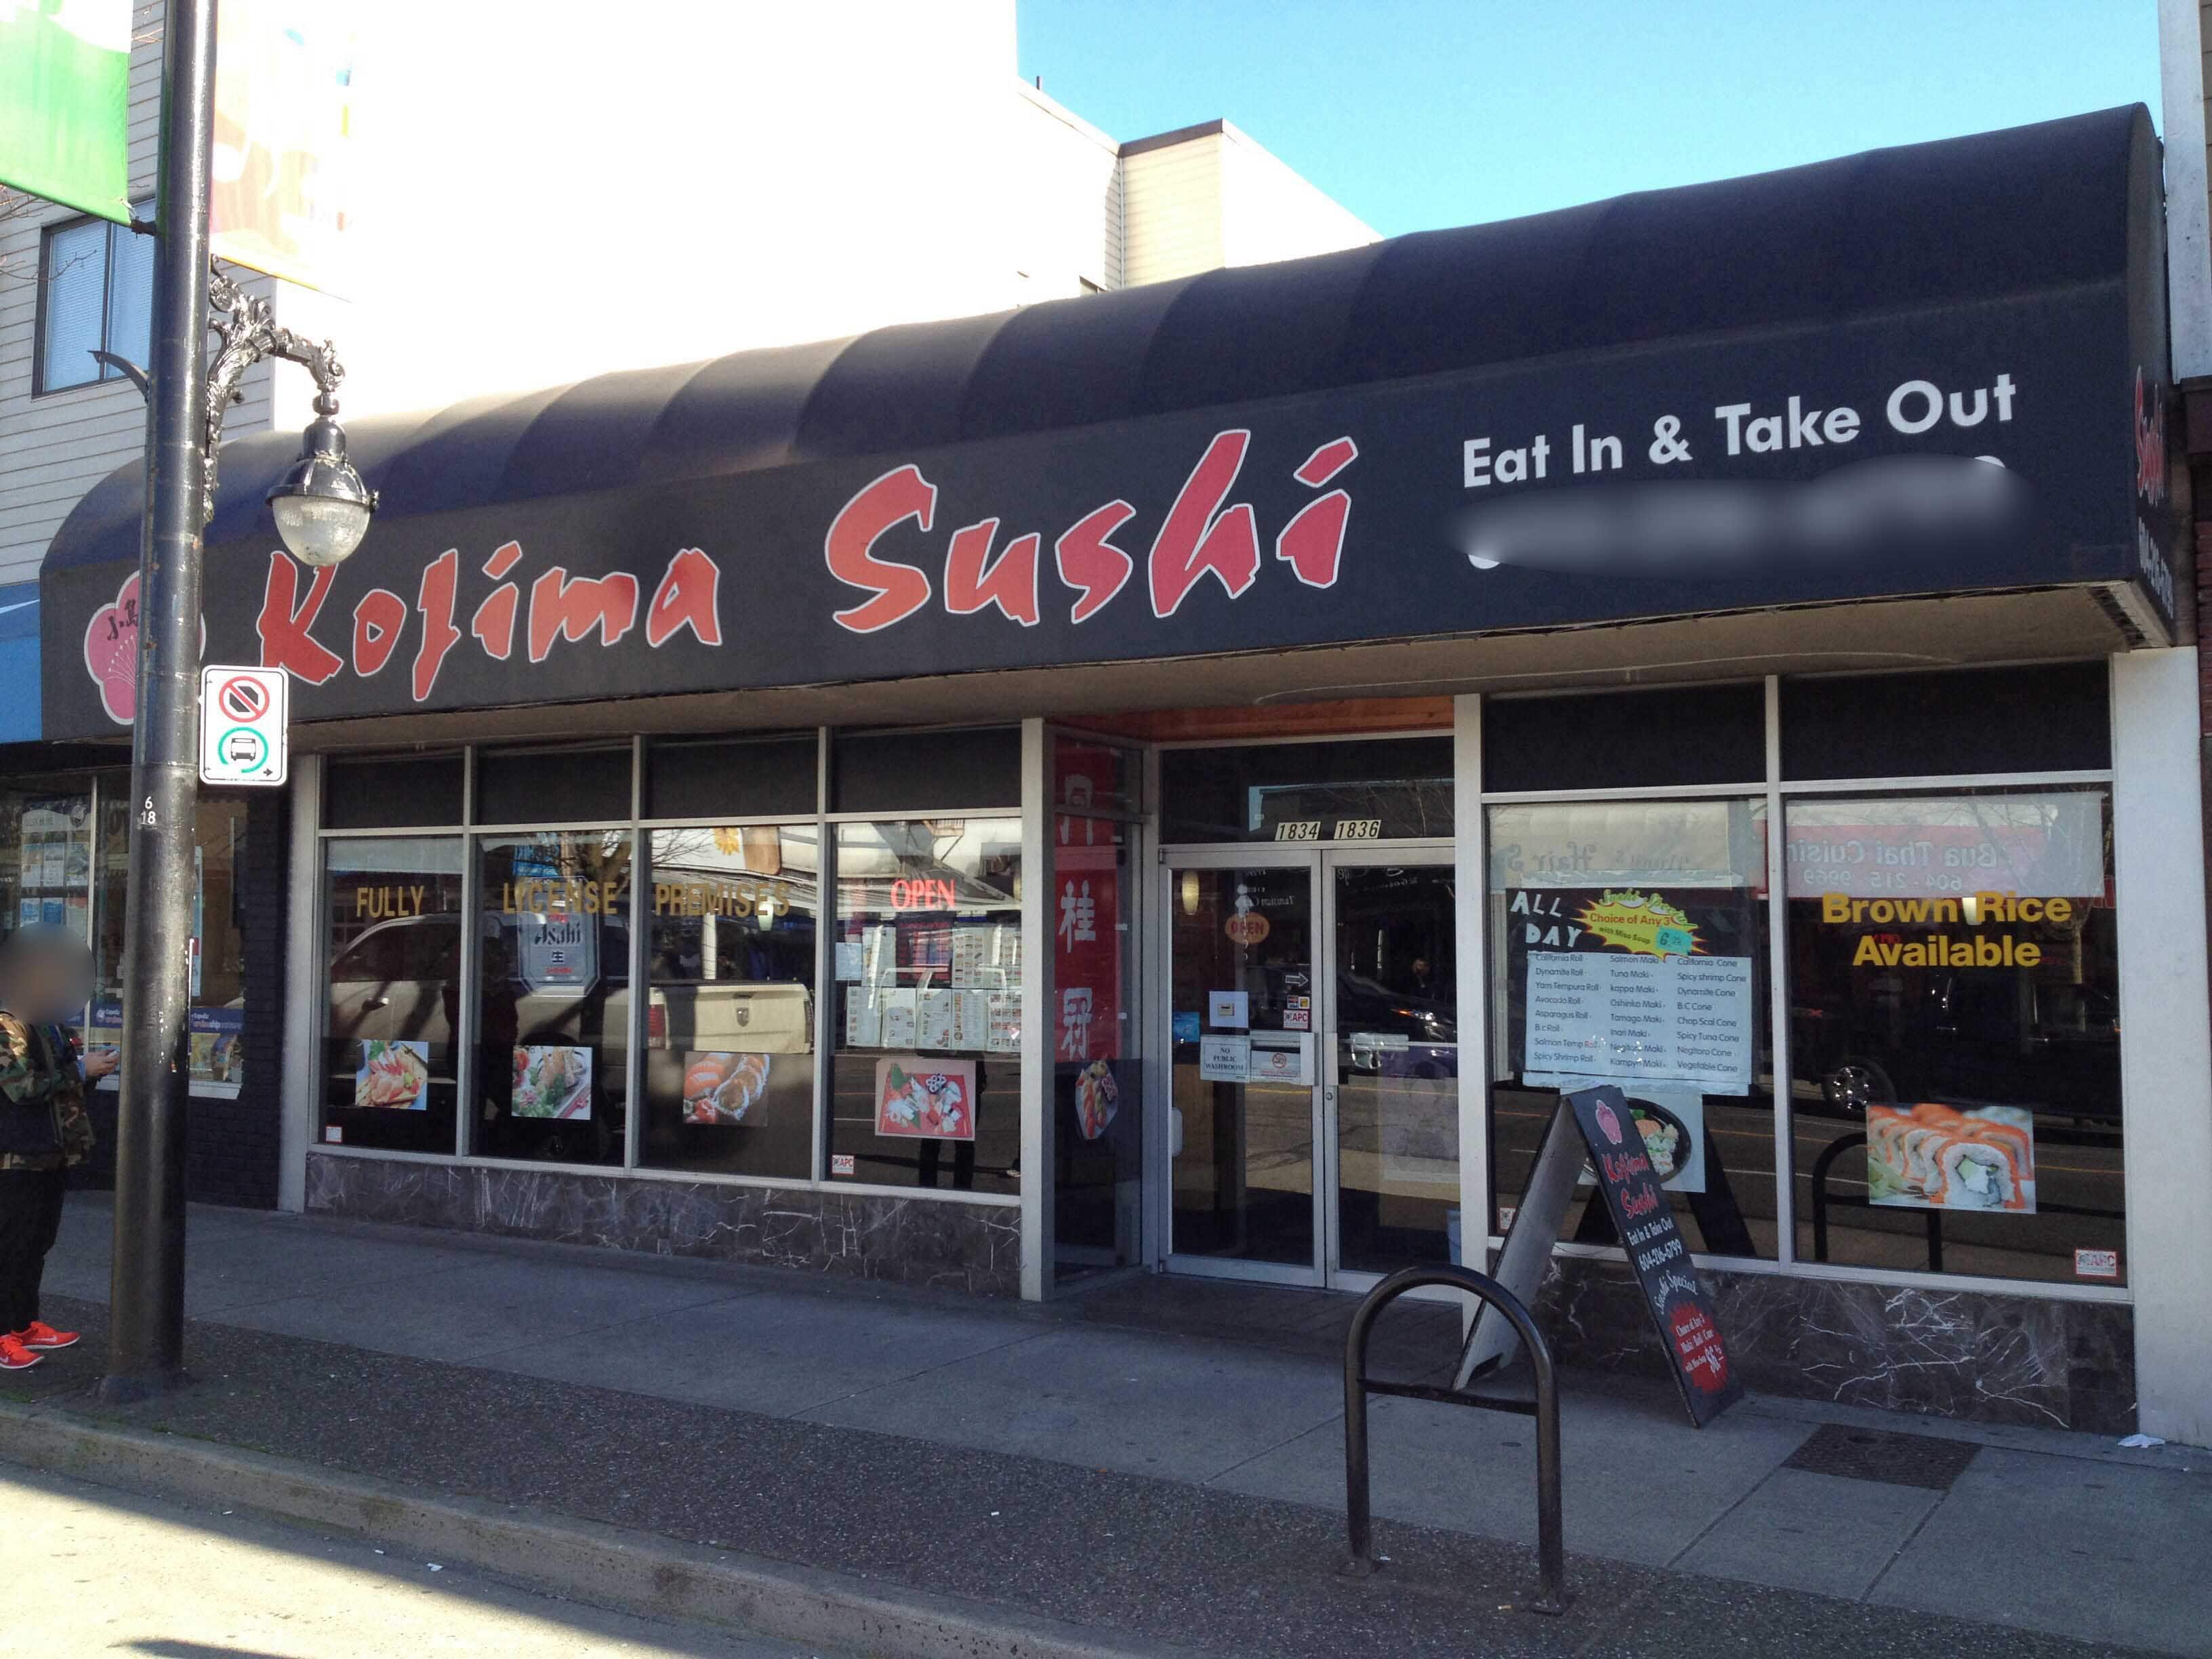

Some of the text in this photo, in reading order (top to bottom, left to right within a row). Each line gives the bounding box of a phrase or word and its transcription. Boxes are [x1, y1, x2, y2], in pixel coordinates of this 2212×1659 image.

[1463, 373, 2017, 489] Eat In & Take Out
[256, 541, 722, 701] Kojima
[825, 428, 1359, 634] Sushi
[144, 796, 153, 809] 6
[140, 811, 157, 824] 18
[1277, 820, 1379, 840] 1834 1836
[890, 878, 957, 909] OPEN
[356, 885, 424, 918] FULLY
[655, 882, 792, 916] PREMISES
[1510, 890, 1562, 918] ALL
[1822, 891, 2072, 923] Brown Rice
[1590, 913, 1671, 927] Choice of Any 3
[534, 922, 581, 945] Asahi
[1230, 920, 1265, 935] OPEN
[1525, 922, 1582, 948] DAY
[1852, 935, 2041, 966] Available
[1610, 955, 1638, 963] Salmon
[1717, 959, 1738, 967] Cone
[1535, 968, 1570, 976] Dynamite
[1677, 972, 1697, 981] Spicy
[1553, 983, 1585, 991] Tempura
[1677, 987, 1736, 997] Dynamite Cone
[1610, 999, 1662, 1008] Oshinko Maki
[1535, 1010, 1589, 1019] Asparagus Roll
[1611, 1013, 1641, 1023] Tamago
[1677, 1017, 1698, 1025] Chop
[1716, 1019, 1737, 1027] Cone
[1677, 1031, 1740, 1042] Spicy Tuna Cone
[1534, 1038, 1561, 1046] Salmon
[1563, 1039, 1583, 1048] Temp
[1644, 1044, 1662, 1052] Maki
[1534, 1052, 1593, 1063] Spicy Shrimp Roll
[1711, 1048, 1732, 1057] Cone
[1205, 1063, 1244, 1071] WASHROOM
[1677, 1060, 1738, 1072] Vegetable Cone
[1620, 1182, 1659, 1219] Sushi
[1626, 1231, 1638, 1246] Eat
[1638, 1227, 1645, 1242] In
[1649, 1222, 1662, 1237] Take
[1661, 1217, 1675, 1231] Out
[1654, 1269, 1698, 1315] Sushi Special
